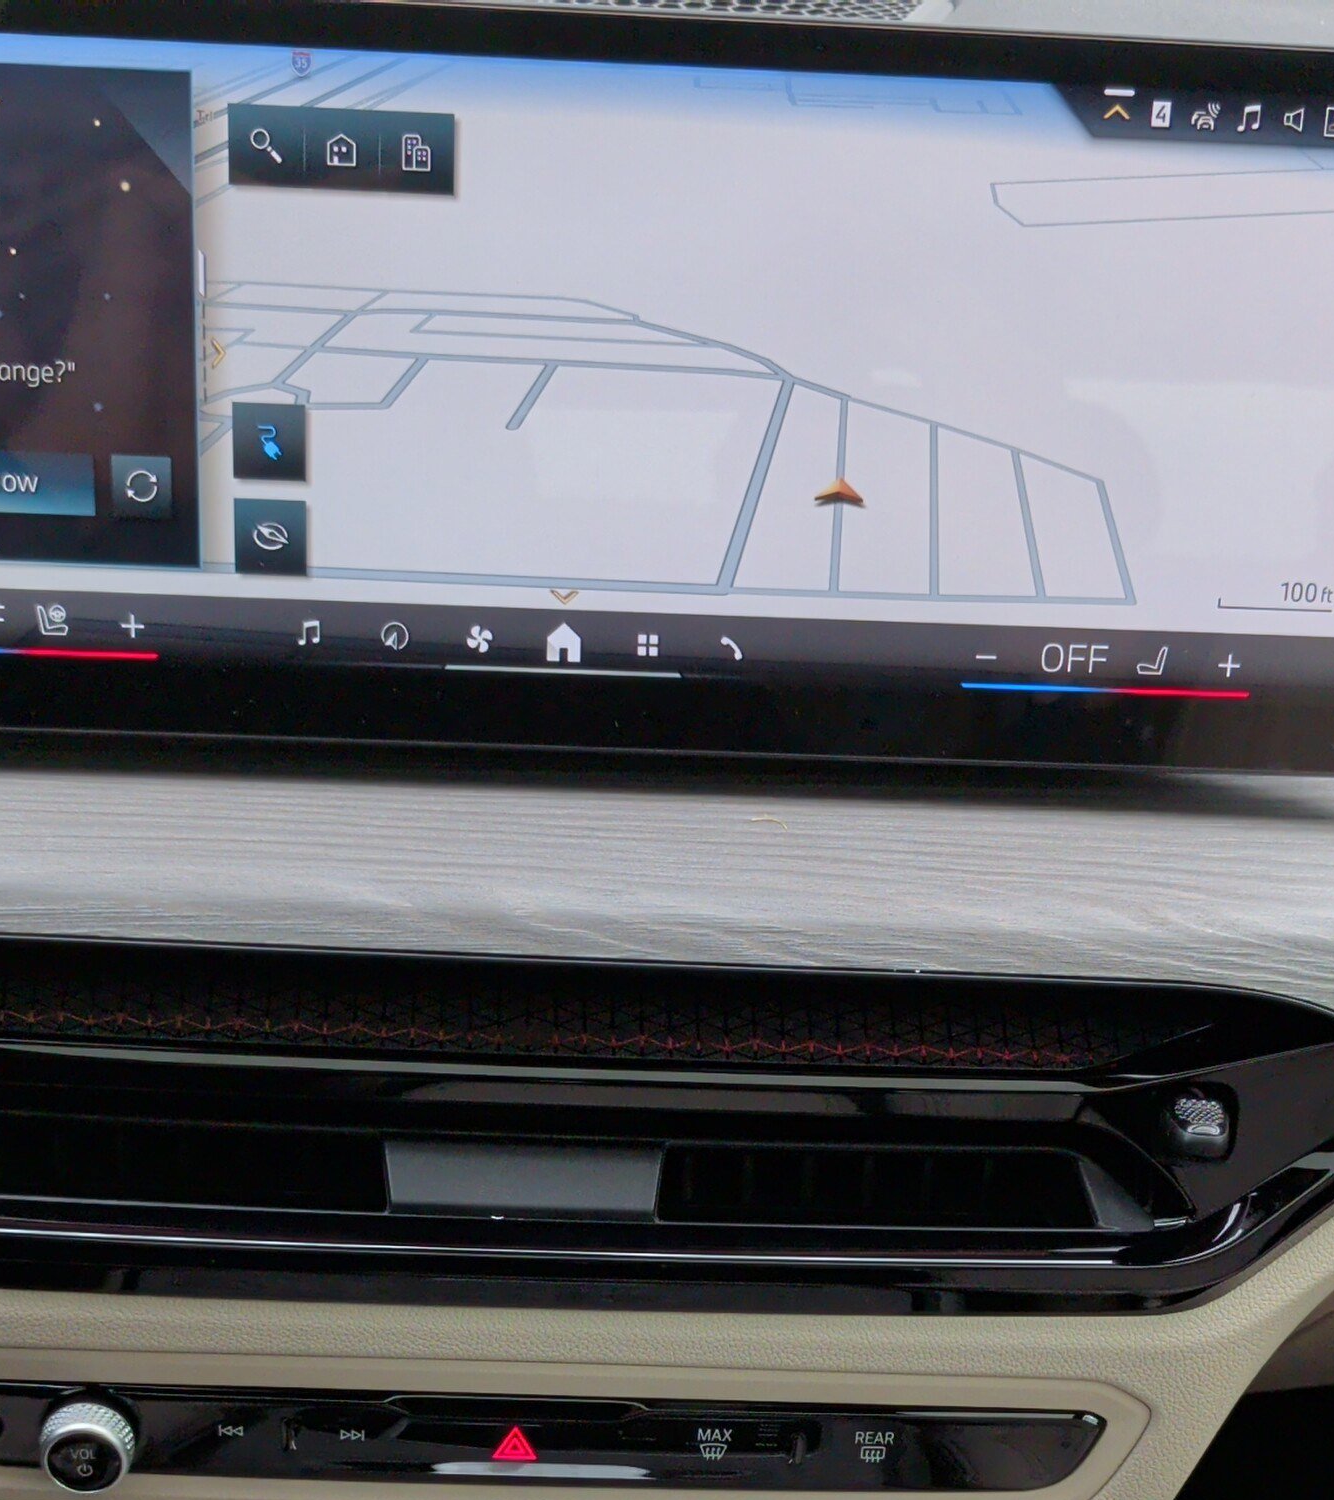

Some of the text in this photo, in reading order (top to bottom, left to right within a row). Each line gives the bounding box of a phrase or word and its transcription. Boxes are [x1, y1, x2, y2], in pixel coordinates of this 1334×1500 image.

[1280, 581, 1334, 604] 100 ft
[1040, 643, 1110, 674] OFF
[697, 1428, 733, 1442] MAX
[855, 1431, 895, 1446] REAR
[69, 1448, 97, 1460] VOL
